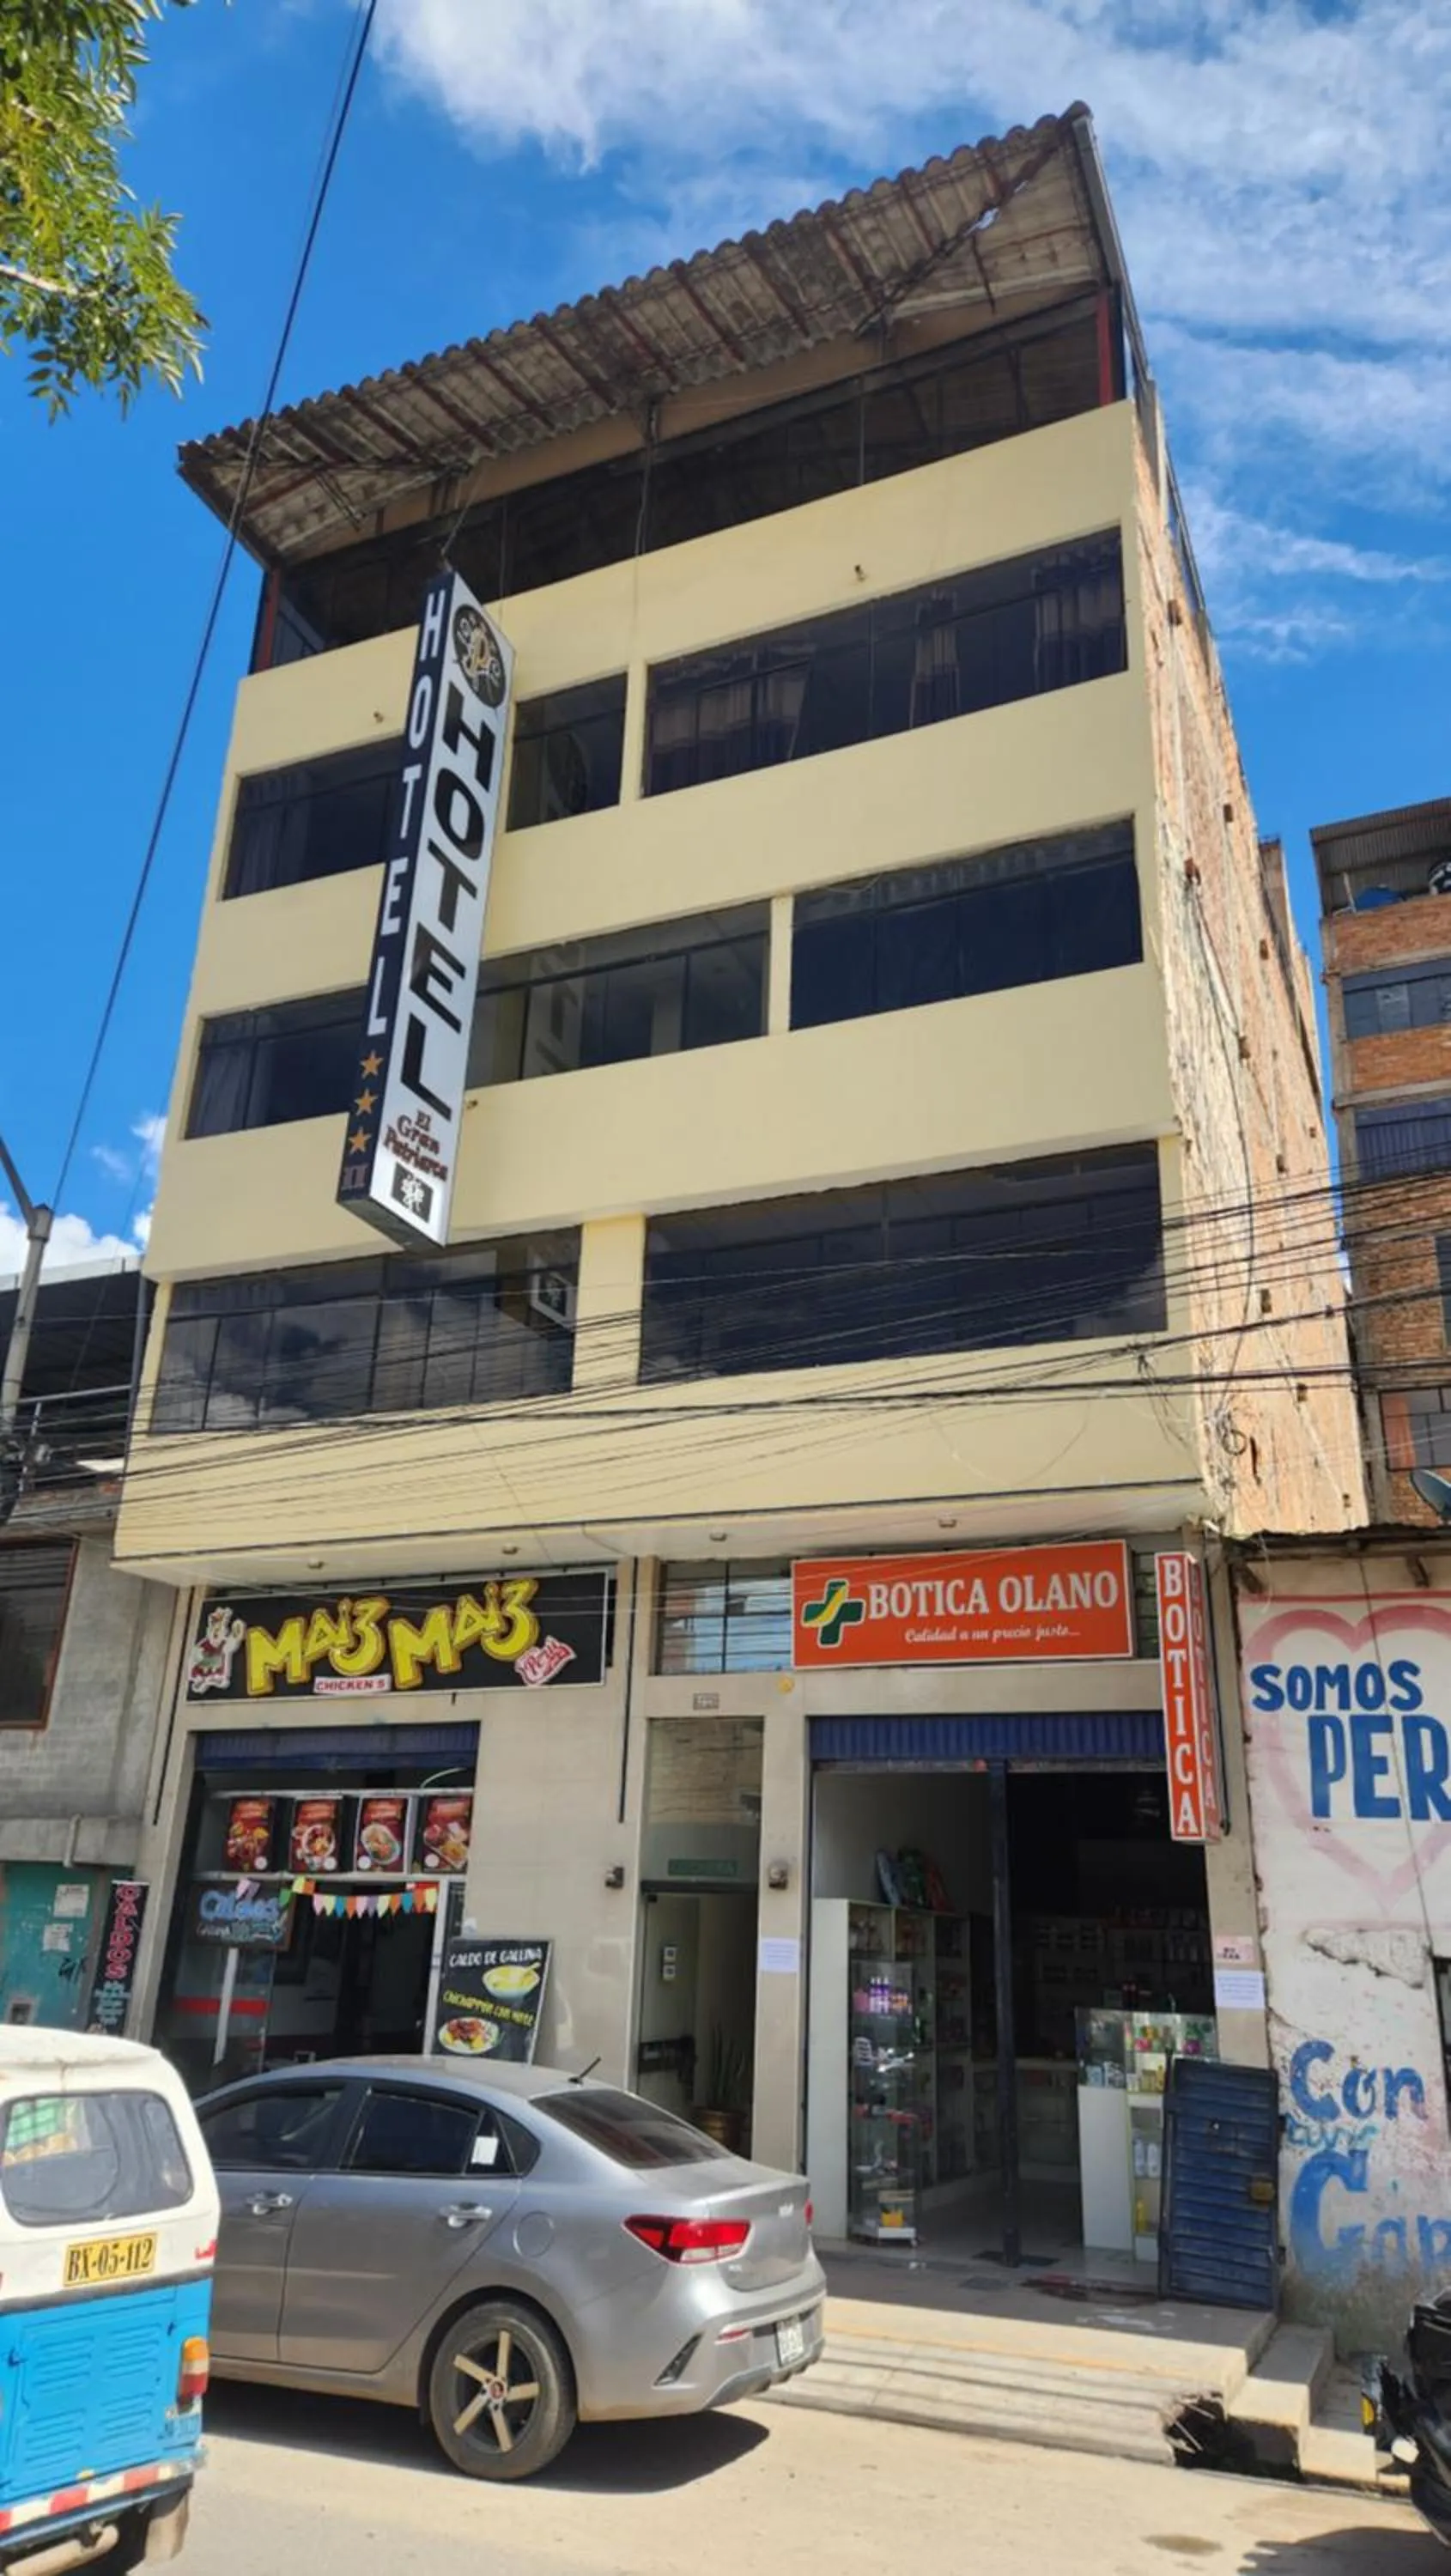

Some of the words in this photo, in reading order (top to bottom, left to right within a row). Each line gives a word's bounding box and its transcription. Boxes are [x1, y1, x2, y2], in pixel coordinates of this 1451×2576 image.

[367, 589, 446, 1036] HOTEL
[400, 681, 495, 1121] HOTEL
[397, 1115, 440, 1154] Gran
[867, 1578, 989, 1620] BOTICA
[999, 1571, 1118, 1613] OLANO
[905, 1626, 957, 1643] Calidad
[959, 1631, 968, 1641] a
[972, 1630, 988, 1640] un
[992, 1626, 1032, 1643] precio
[1163, 1558, 1199, 1834] BOTICA
[1250, 1659, 1423, 1711] SOMOS
[1307, 1714, 1451, 1821] PER
[105, 1885, 140, 1979] CALDOS
[449, 1952, 483, 1968] CALDO
[483, 1950, 497, 1965] DE
[1290, 2039, 1428, 2122] Con
[68, 2237, 153, 2281] BX-05-112
